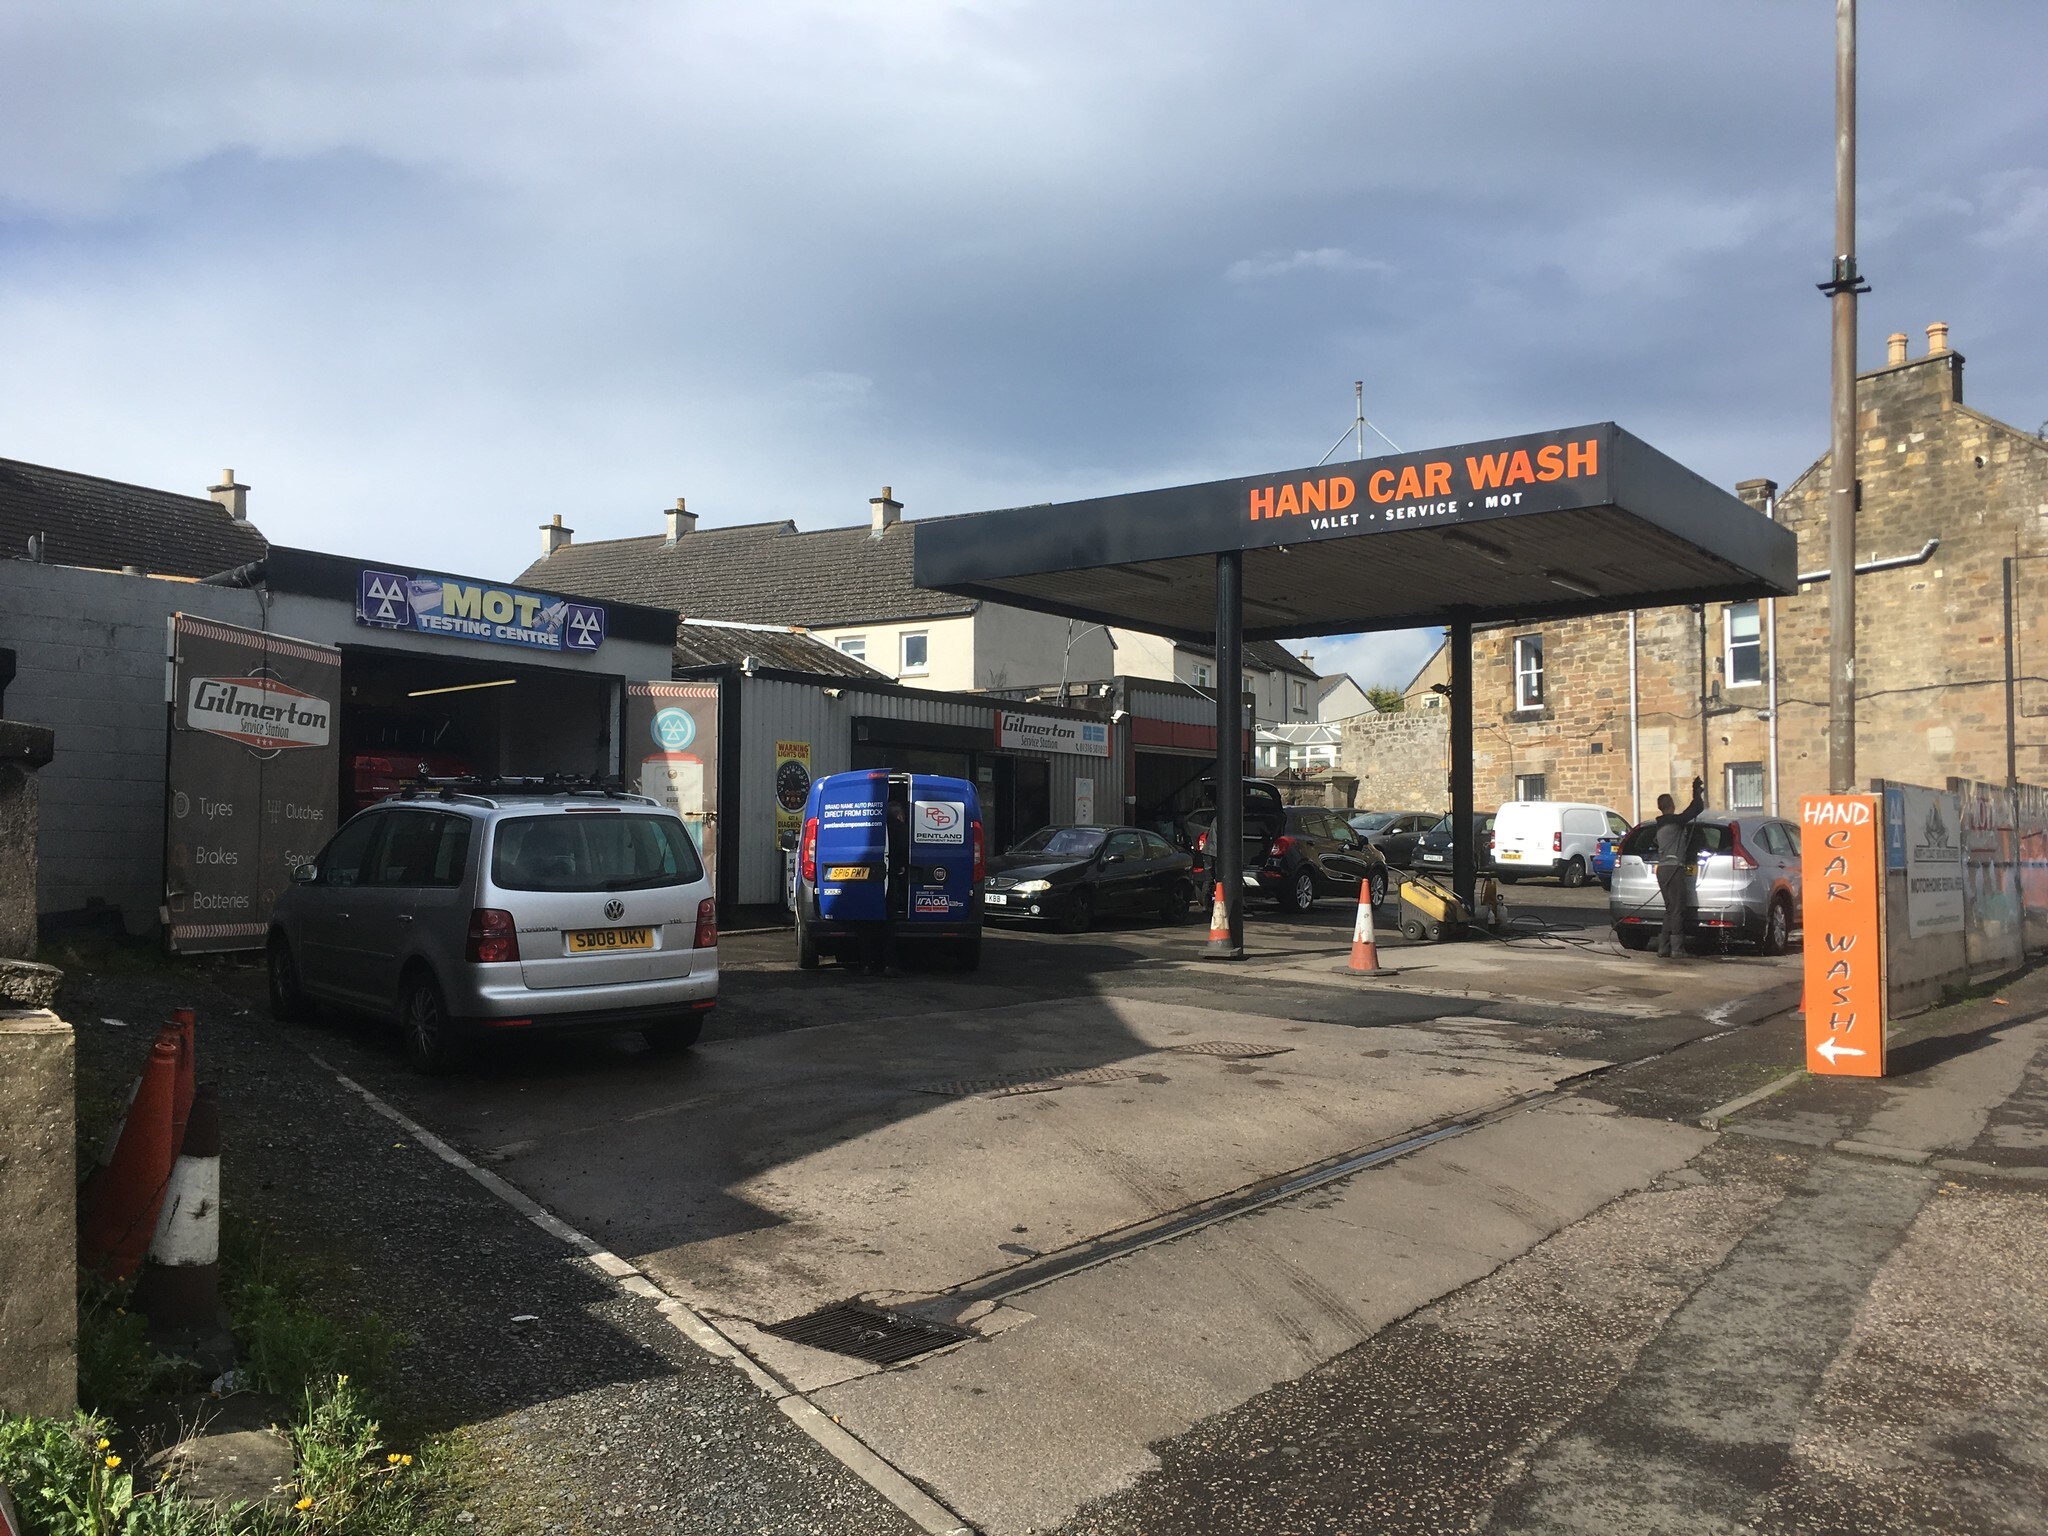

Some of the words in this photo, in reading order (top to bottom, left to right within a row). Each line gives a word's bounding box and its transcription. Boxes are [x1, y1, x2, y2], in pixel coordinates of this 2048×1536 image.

[1250, 477, 1355, 521] HAND
[1369, 462, 1451, 503] CAR
[1465, 440, 1598, 490] WASH
[1311, 514, 1359, 530] VALET
[1385, 501, 1458, 521] SERVICE
[1485, 493, 1523, 508] MOT
[442, 583, 541, 628] MOT
[418, 614, 491, 637] TESTING
[496, 626, 559, 646] CENTRE
[194, 681, 326, 729] Gilmerton
[240, 718, 264, 735] Service
[265, 722, 289, 738] Station
[1002, 715, 1075, 739] Gilmerton
[778, 744, 809, 752] WARNING
[1021, 735, 1040, 748] Service
[1040, 737, 1058, 749] Station
[200, 798, 233, 820] Tyres
[286, 803, 324, 820] Clutches
[824, 810, 843, 818] DIRECT
[844, 809, 861, 817] FROM
[862, 808, 883, 816] STOCK
[1804, 801, 1870, 825] HAND
[196, 847, 238, 865] Brakes
[1824, 830, 1853, 902] CAR
[833, 868, 850, 878] SP16
[851, 868, 867, 878] PMY
[193, 891, 249, 909] Batteries
[575, 932, 616, 947] SD08
[619, 930, 646, 945] UKV
[1825, 933, 1857, 1033] WASH
